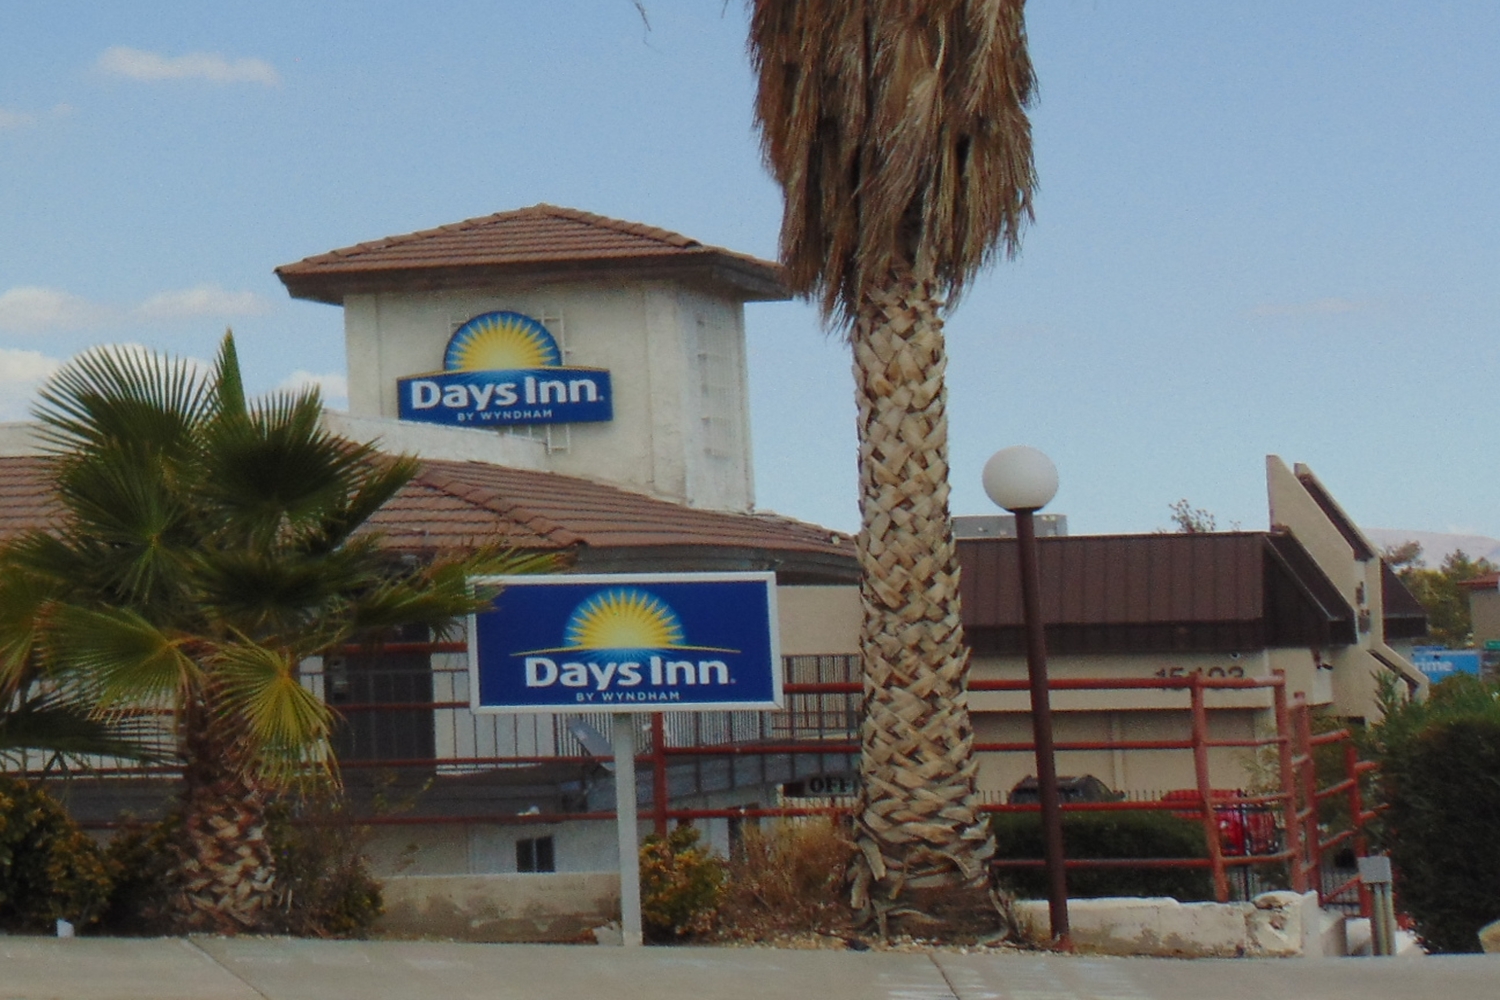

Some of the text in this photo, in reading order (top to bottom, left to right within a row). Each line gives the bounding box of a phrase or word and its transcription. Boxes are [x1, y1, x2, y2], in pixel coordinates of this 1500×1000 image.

[411, 376, 598, 410] Days Inn
[457, 410, 553, 422] BY WYNDHAM
[525, 655, 728, 690] Days Inn
[577, 691, 680, 702] BY WYNDHAM
